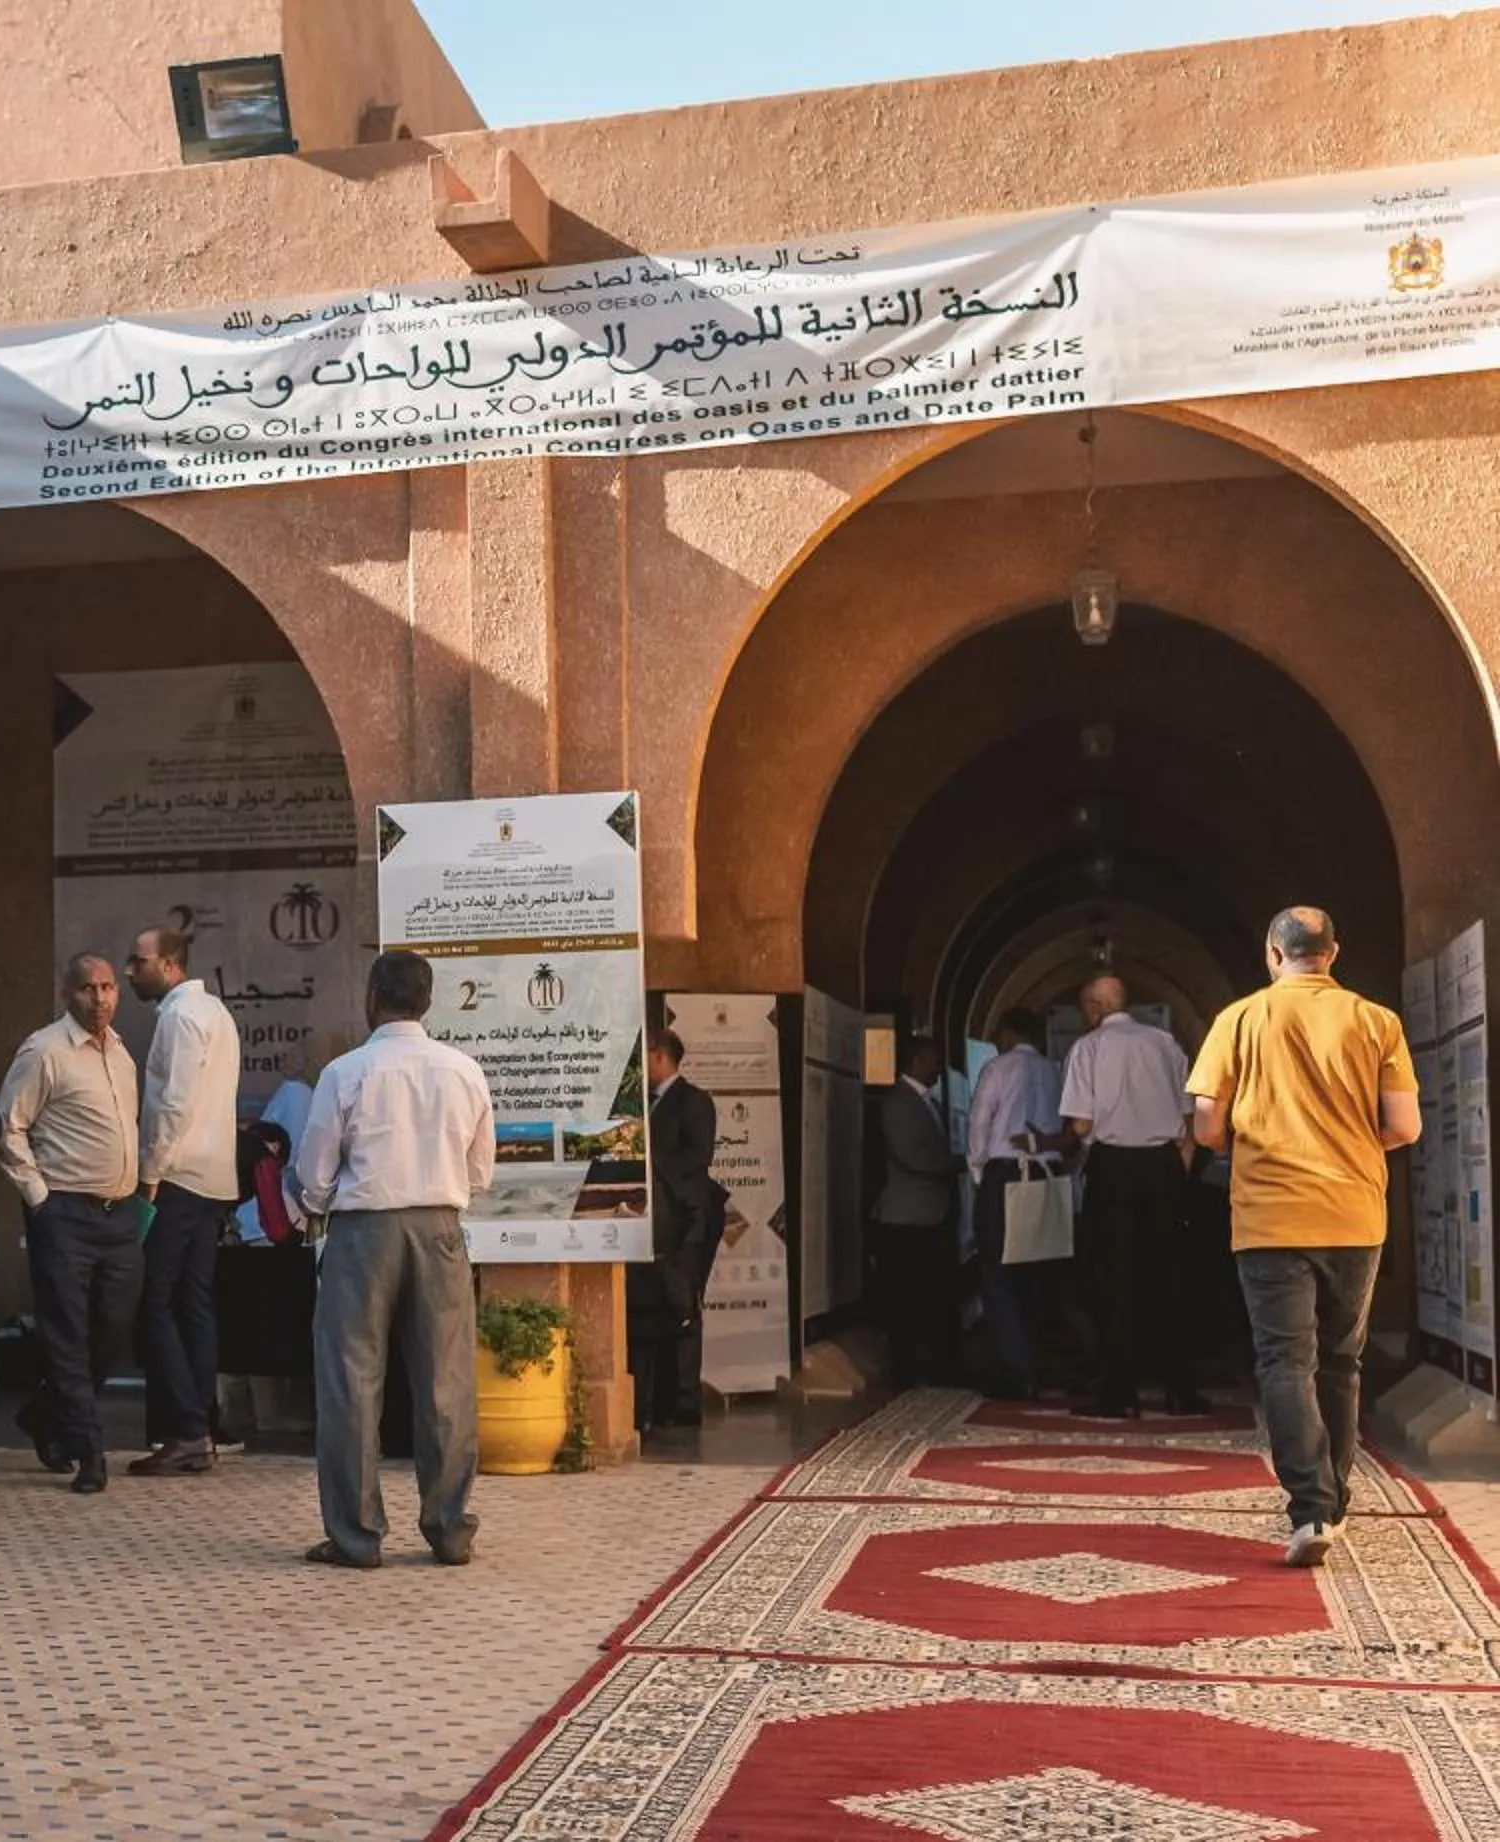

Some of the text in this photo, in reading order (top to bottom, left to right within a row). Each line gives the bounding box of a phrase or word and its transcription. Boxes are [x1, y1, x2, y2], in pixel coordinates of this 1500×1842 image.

[797, 245, 861, 265] تحت
[536, 267, 632, 296] لصاحب
[411, 294, 457, 308] محمد
[222, 310, 253, 332] الله
[257, 309, 313, 336] نصره
[42, 270, 1079, 432] النسخة الثانية للمؤتمر الدولي للواحات و نخيل التمر
[42, 366, 1085, 481] Deuxième édition du Congrès international des oasis et du palmier dattier
[39, 389, 1086, 501] Second Edition of the International Congress on Oases and Date Palm
[459, 980, 478, 1011] 2
[240, 1023, 315, 1048] iption
